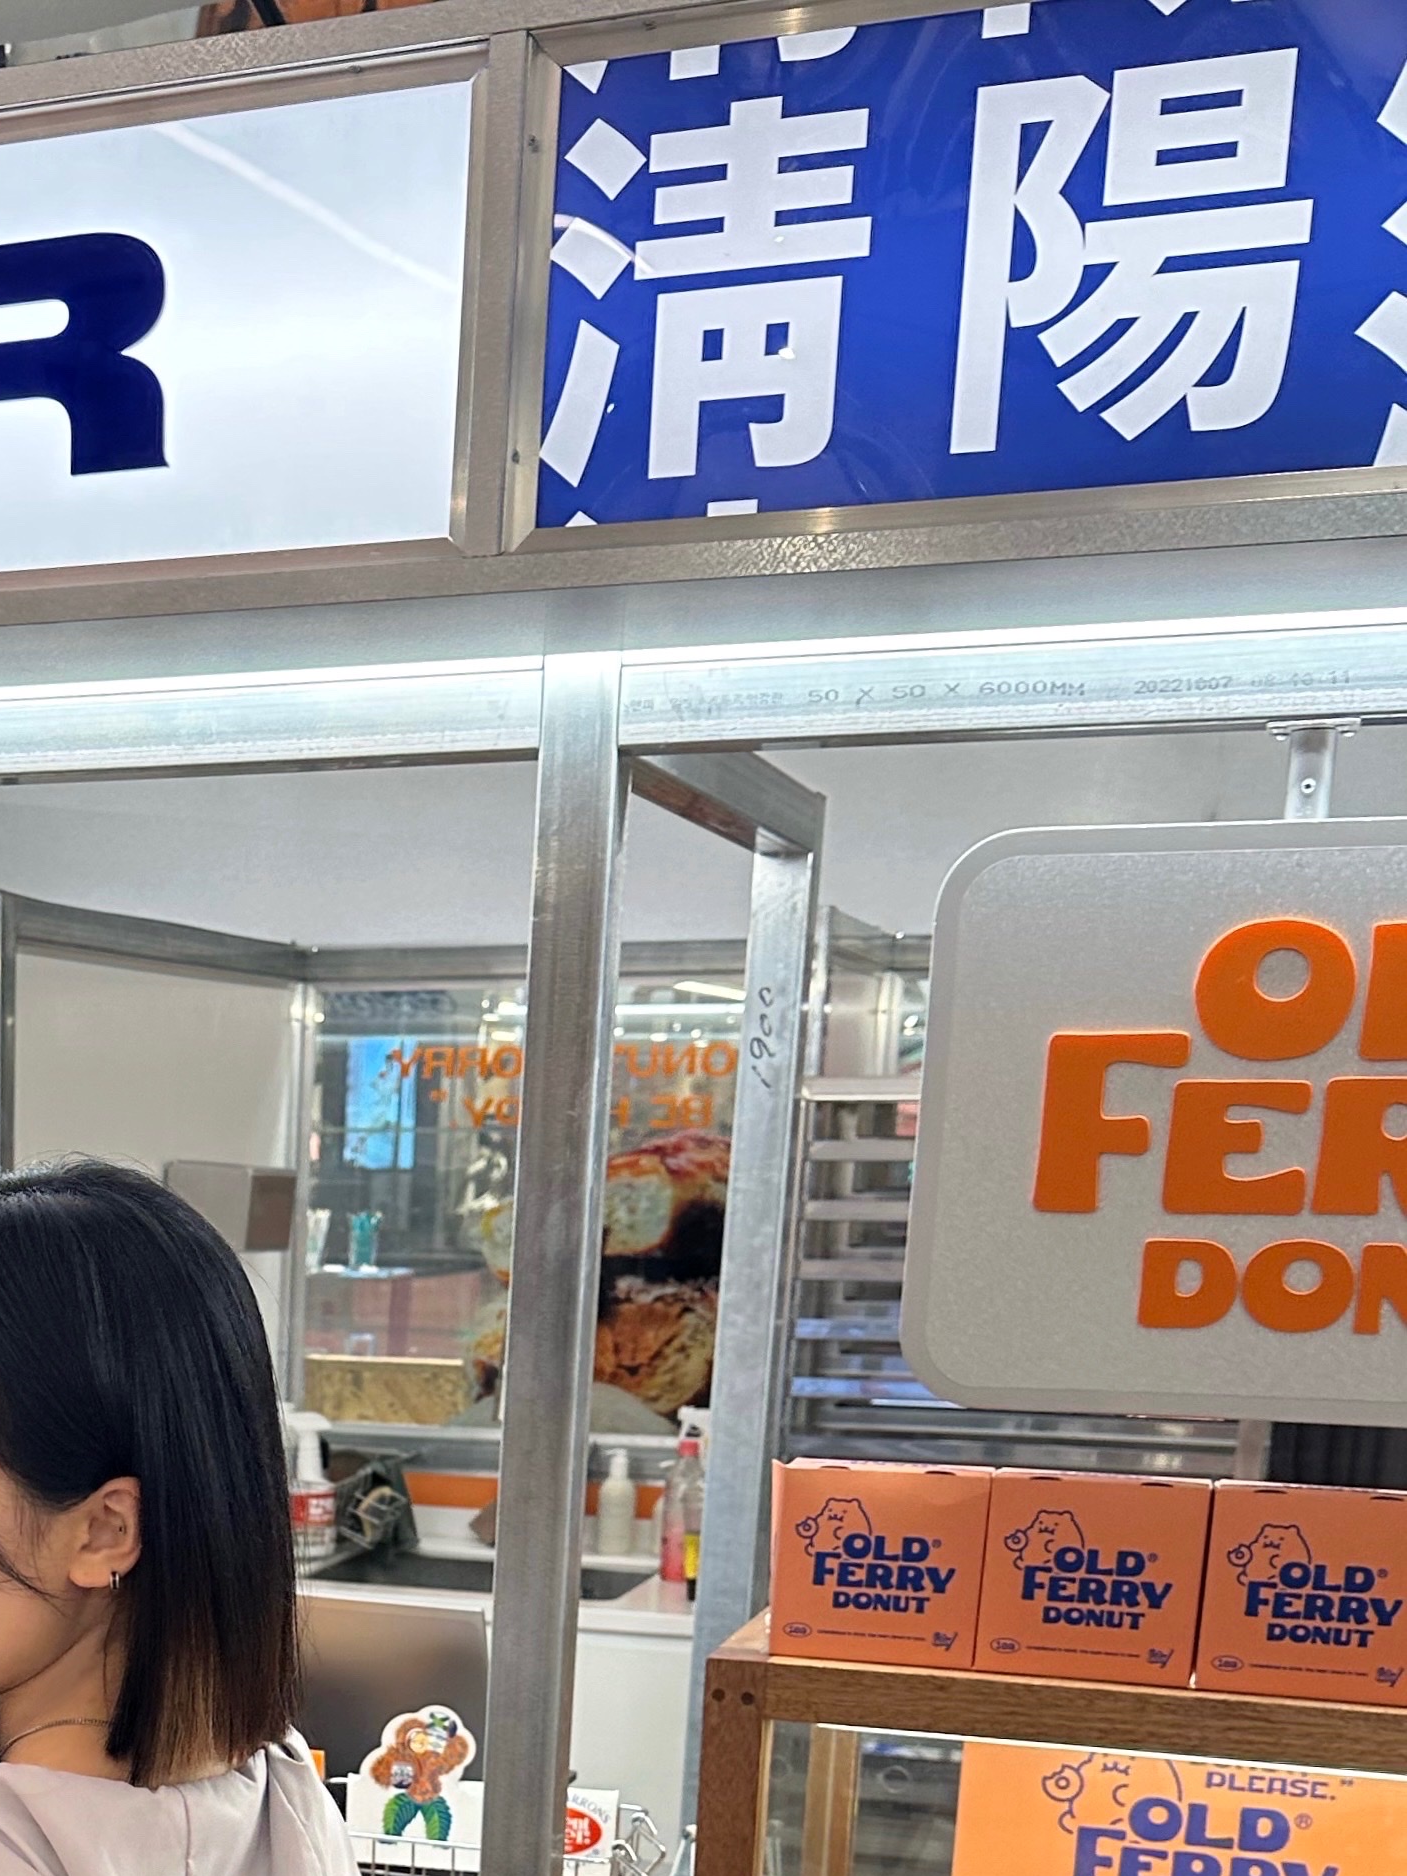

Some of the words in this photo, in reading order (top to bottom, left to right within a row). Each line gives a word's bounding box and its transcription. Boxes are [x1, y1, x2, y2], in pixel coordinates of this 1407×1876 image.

[842, 1532, 931, 1563] OLD
[1053, 1545, 1147, 1577] OLD
[812, 1551, 957, 1595] FERRY
[1021, 1564, 1174, 1610] FERRY
[1278, 1561, 1376, 1594] OLD
[831, 1590, 931, 1614] DONUT
[1041, 1605, 1146, 1630] DONUT
[1243, 1580, 1404, 1627] FERRY
[1266, 1622, 1375, 1649] DONUT
[1128, 1796, 1291, 1853] OLD
